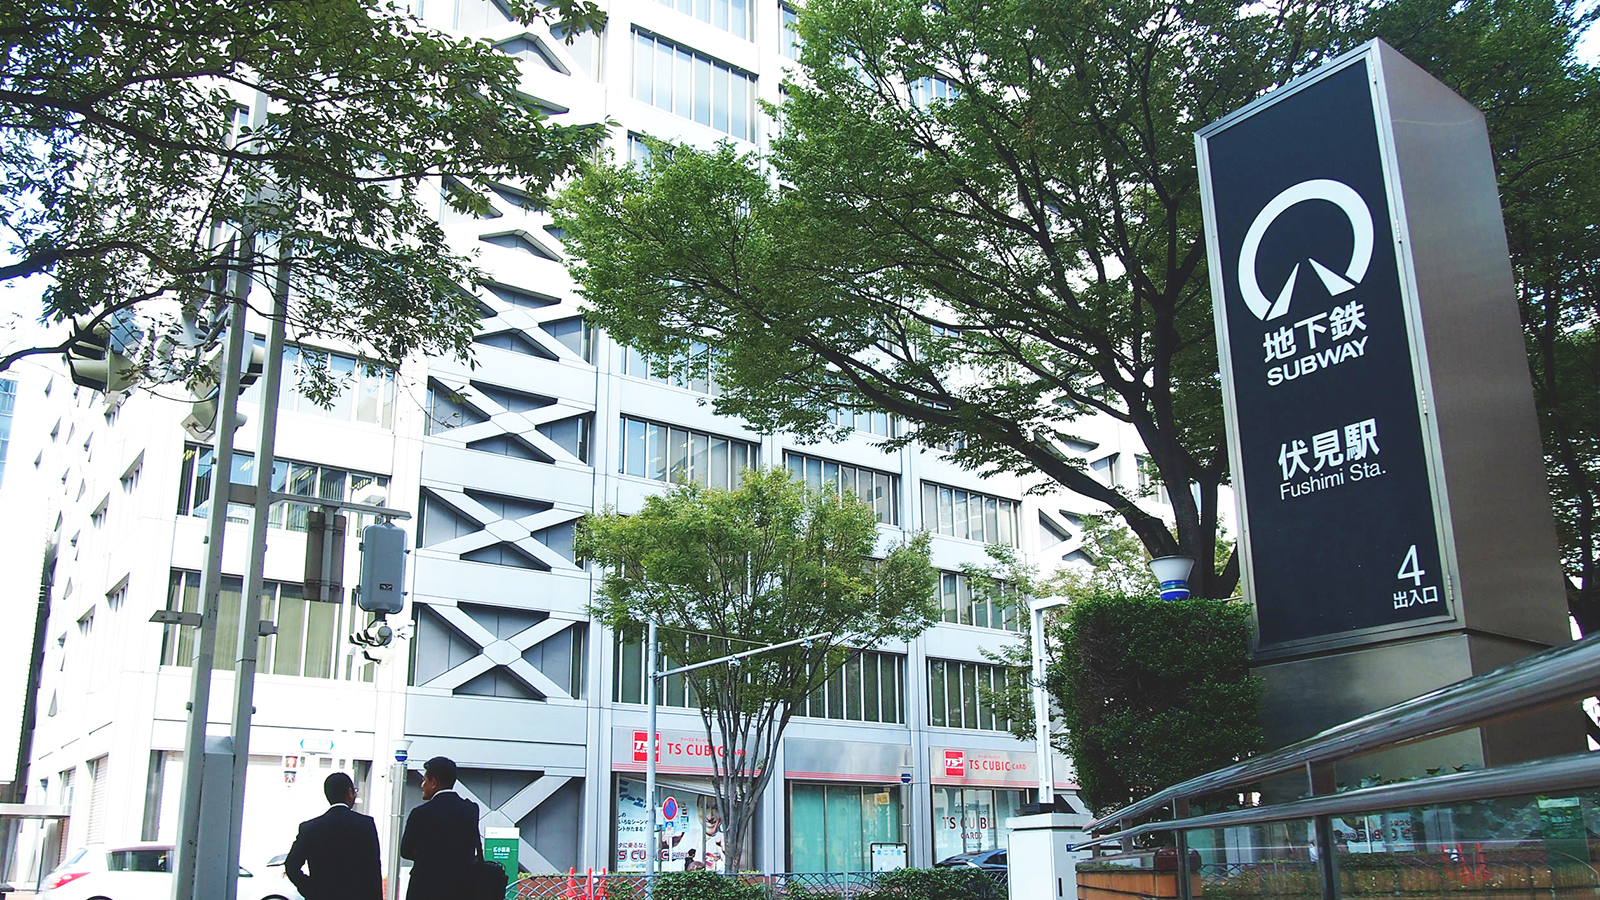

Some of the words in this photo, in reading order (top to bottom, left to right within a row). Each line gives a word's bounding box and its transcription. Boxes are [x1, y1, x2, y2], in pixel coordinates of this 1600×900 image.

[1263, 301, 1367, 363] 地下鉄
[1267, 336, 1368, 386] SUBWAY
[1278, 417, 1380, 480] 伏見駅
[1280, 468, 1345, 500] Fushimi
[1350, 462, 1386, 481] Sta.
[1397, 544, 1425, 586] 4
[1393, 586, 1438, 609] 出入口
[667, 743, 682, 755] TS
[969, 760, 980, 770] TS
[982, 760, 1011, 771] CUBIC
[942, 817, 956, 829] TS
